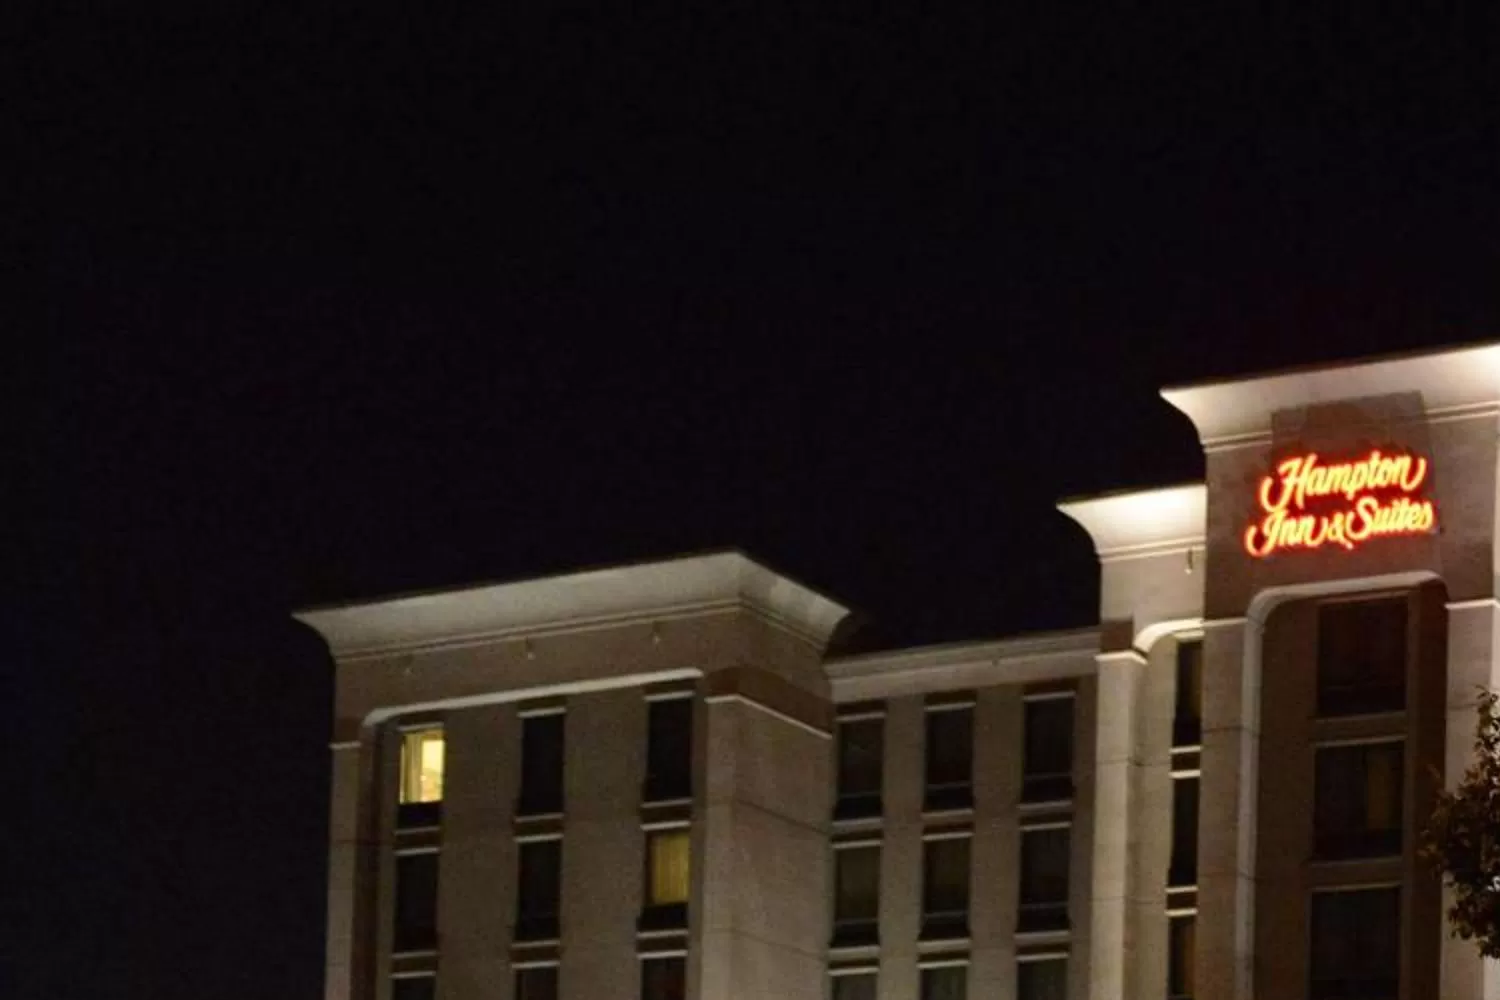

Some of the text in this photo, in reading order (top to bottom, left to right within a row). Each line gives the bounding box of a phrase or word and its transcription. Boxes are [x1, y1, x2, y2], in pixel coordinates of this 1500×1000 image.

[1260, 451, 1427, 511] Hampton
[1245, 496, 1433, 556] Inn & Suites
